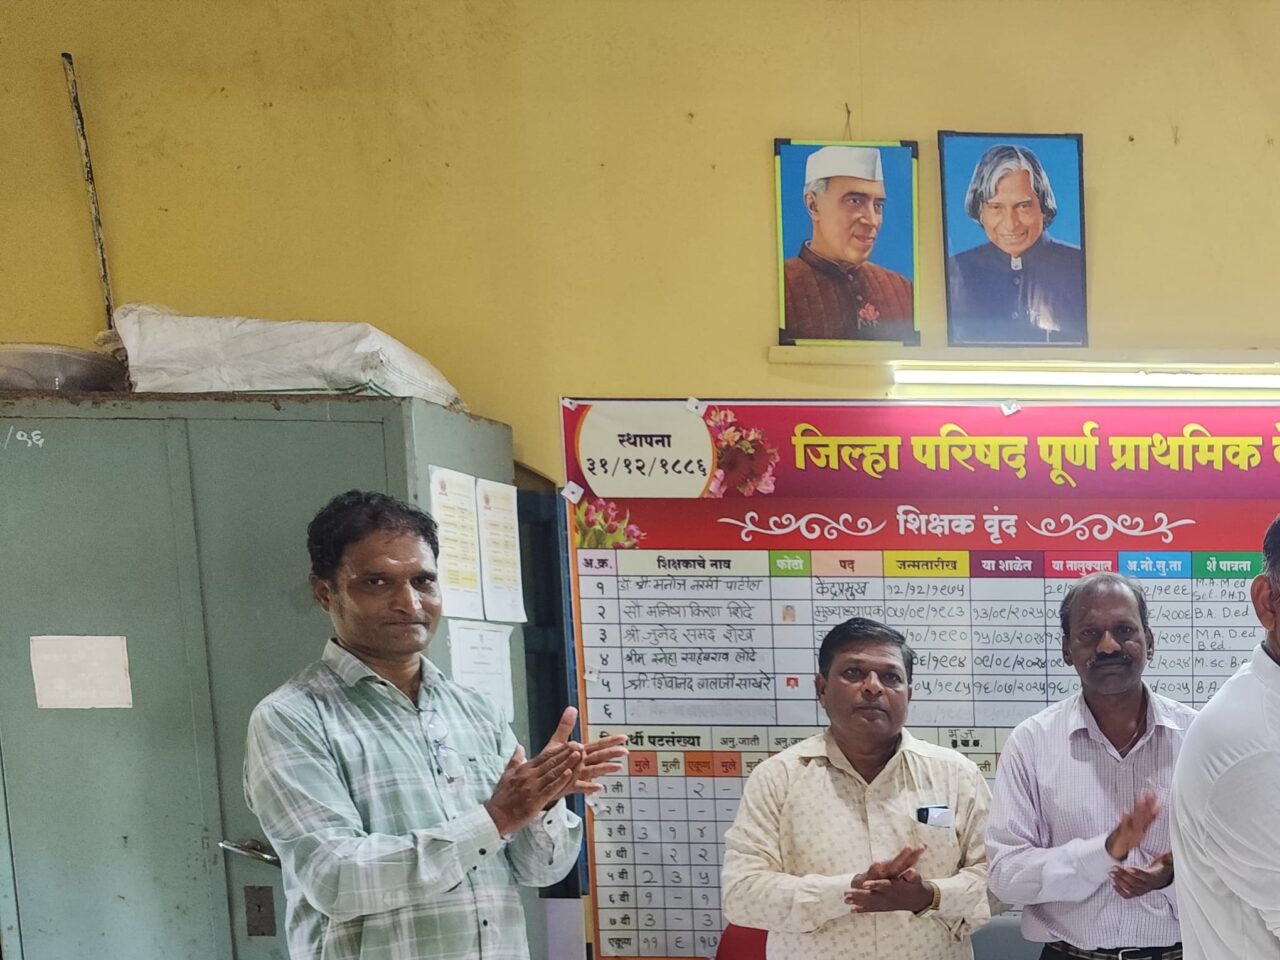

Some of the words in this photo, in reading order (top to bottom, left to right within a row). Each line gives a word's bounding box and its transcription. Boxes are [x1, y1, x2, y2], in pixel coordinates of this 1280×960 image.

[618, 432, 672, 450] स्थापना
[792, 424, 900, 474] जिल्हा
[912, 424, 1027, 480] परिषद
[1037, 421, 1098, 487] पूर्ण
[1109, 424, 1262, 474] प्राथमिक
[897, 506, 974, 536] शिक्षक
[985, 507, 1017, 543] वृंद
[583, 556, 613, 570] अ.क्र.
[657, 554, 706, 570] शिक्षकाचे
[710, 557, 731, 570] नाव
[776, 556, 804, 571] फोटो
[839, 559, 855, 572] पद
[896, 557, 957, 572] जन्मतारीख
[981, 559, 996, 571] या
[998, 556, 1033, 571] शाळेत
[1052, 560, 1064, 571] या
[1066, 560, 1112, 576] तालुक्यात
[1219, 560, 1252, 573] पात्रता
[648, 731, 701, 747] पटसंख्या
[720, 734, 760, 749] अनु.जाती
[634, 759, 650, 771] मुले
[661, 757, 681, 773] मुली
[721, 758, 737, 772] मुले
